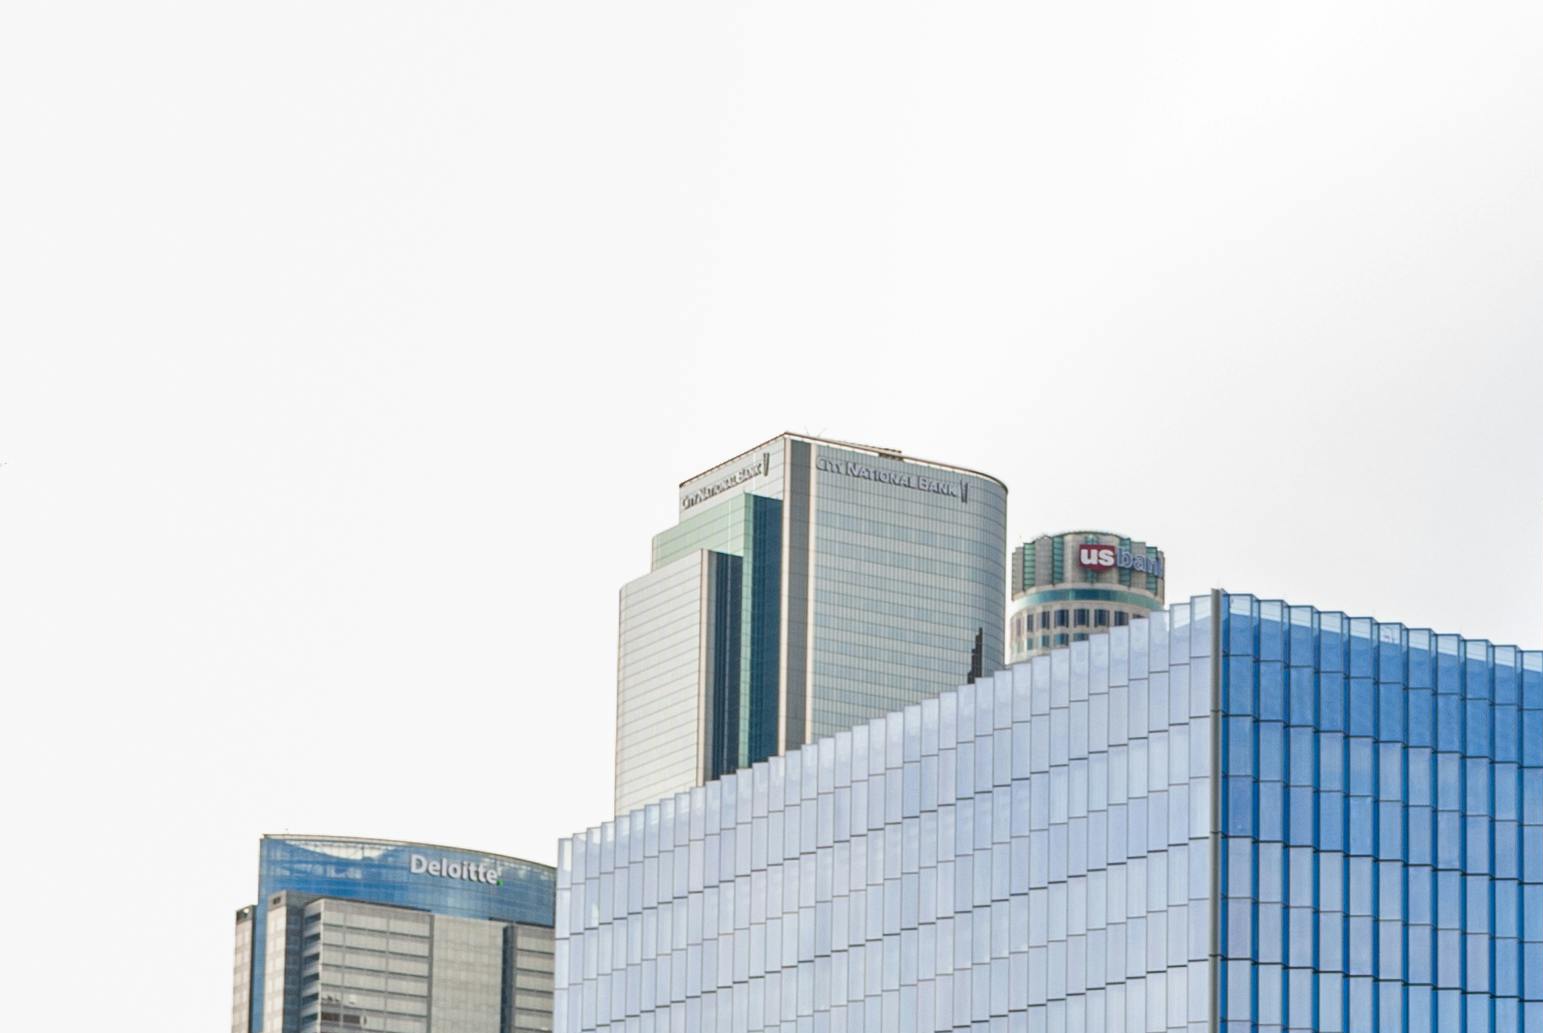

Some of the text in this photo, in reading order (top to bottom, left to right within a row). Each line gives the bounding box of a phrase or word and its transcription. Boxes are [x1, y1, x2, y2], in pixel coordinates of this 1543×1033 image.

[845, 461, 917, 490] NATIONAL
[917, 475, 958, 498] BANK
[1116, 545, 1162, 577] ban
